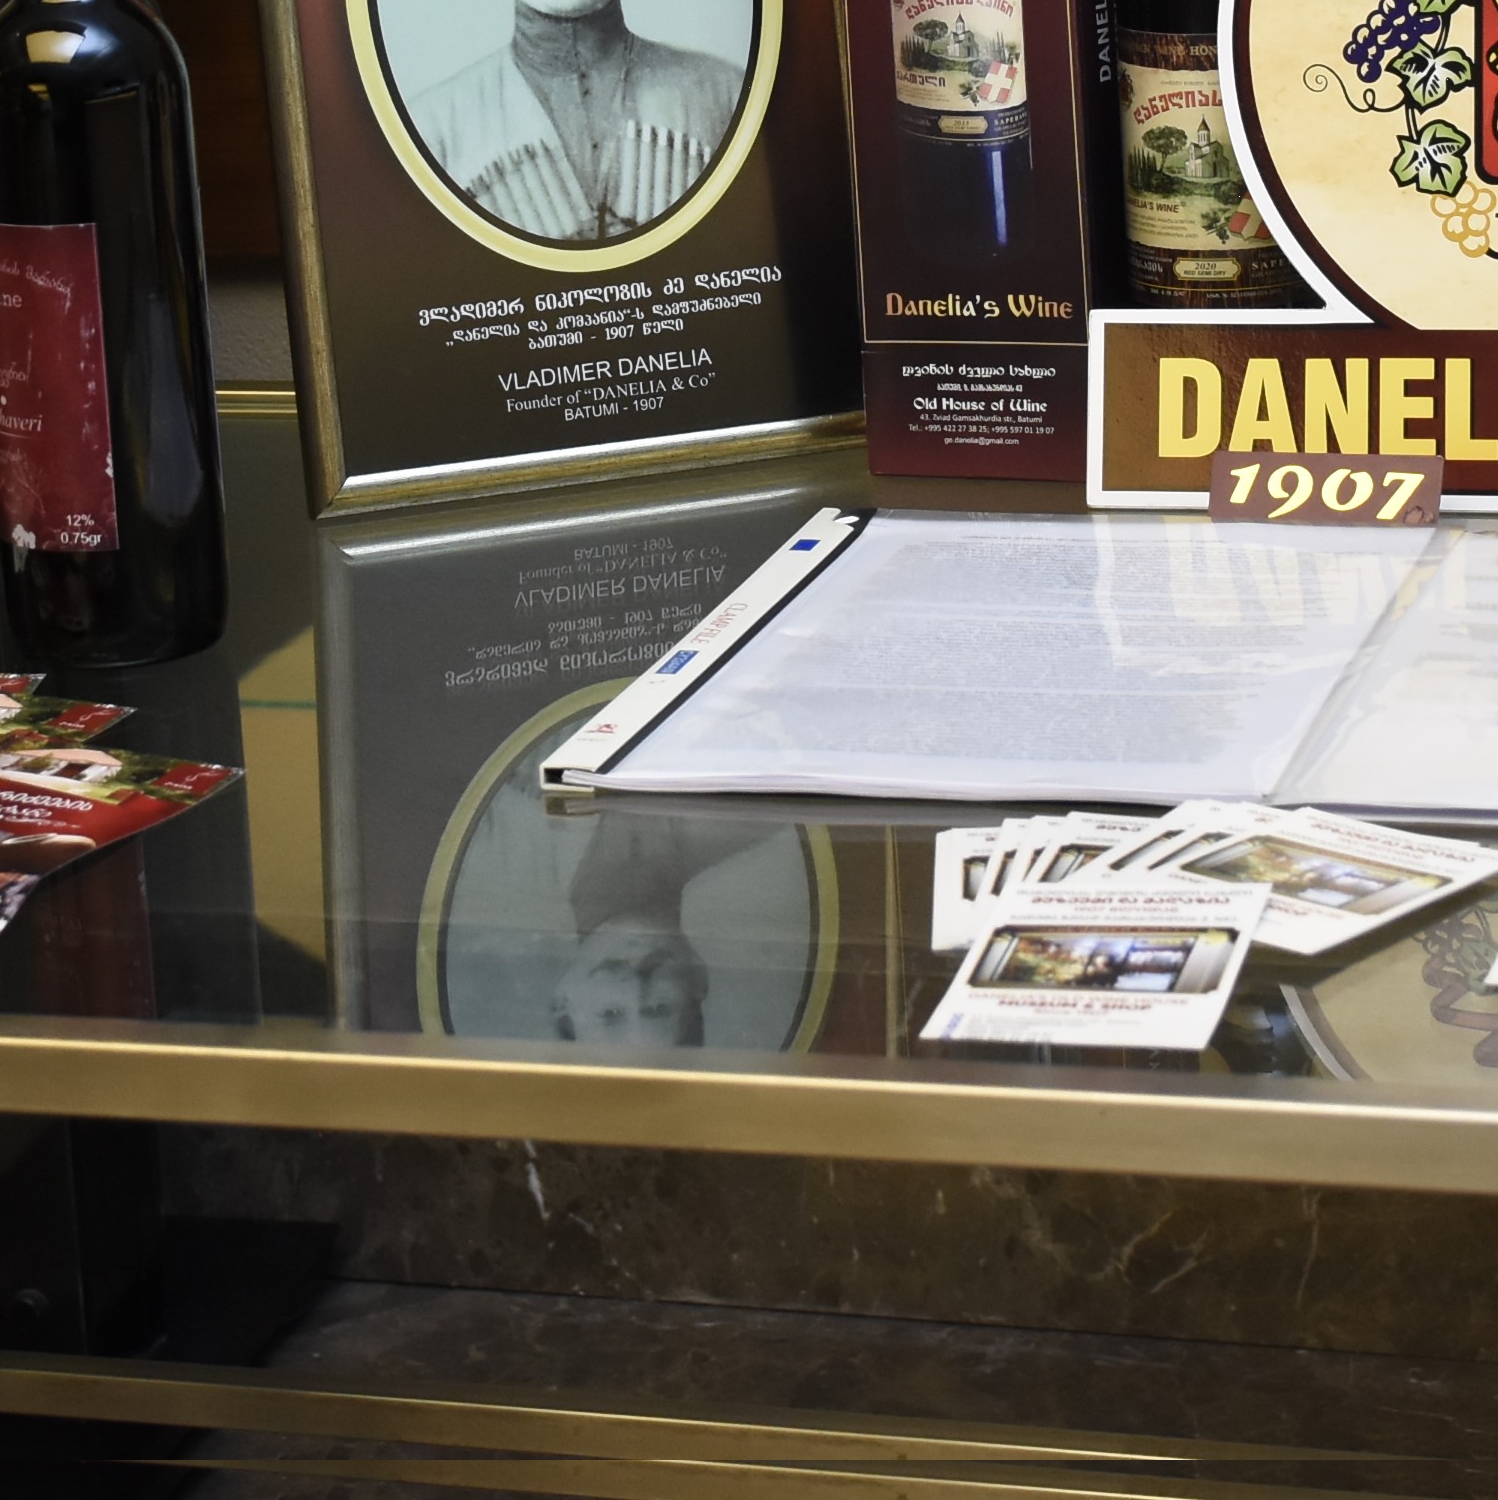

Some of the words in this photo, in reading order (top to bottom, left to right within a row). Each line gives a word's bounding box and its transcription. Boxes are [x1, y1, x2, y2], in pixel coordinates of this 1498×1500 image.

[1194, 262, 1217, 270] 2020
[885, 293, 1000, 319] Danelia's
[1007, 294, 1073, 319] Wine
[497, 360, 613, 392] VLADIMER
[617, 347, 713, 377] DANELIA
[505, 393, 563, 413] Founder
[565, 389, 582, 405] of
[583, 378, 668, 402] “DANELIA
[671, 376, 685, 392] &
[687, 371, 716, 389] Co”
[563, 401, 620, 422] BATUMI
[632, 395, 665, 412] 1907
[913, 397, 937, 411] Old
[942, 398, 986, 411] House
[991, 399, 1004, 411] of
[1009, 399, 1048, 413] Wine
[952, 414, 1001, 422] Gamsakhurdia
[1017, 415, 1043, 423] Batumi
[1229, 461, 1426, 522] 1907
[66, 514, 95, 526] 12%
[61, 532, 102, 547] 0.75gr
